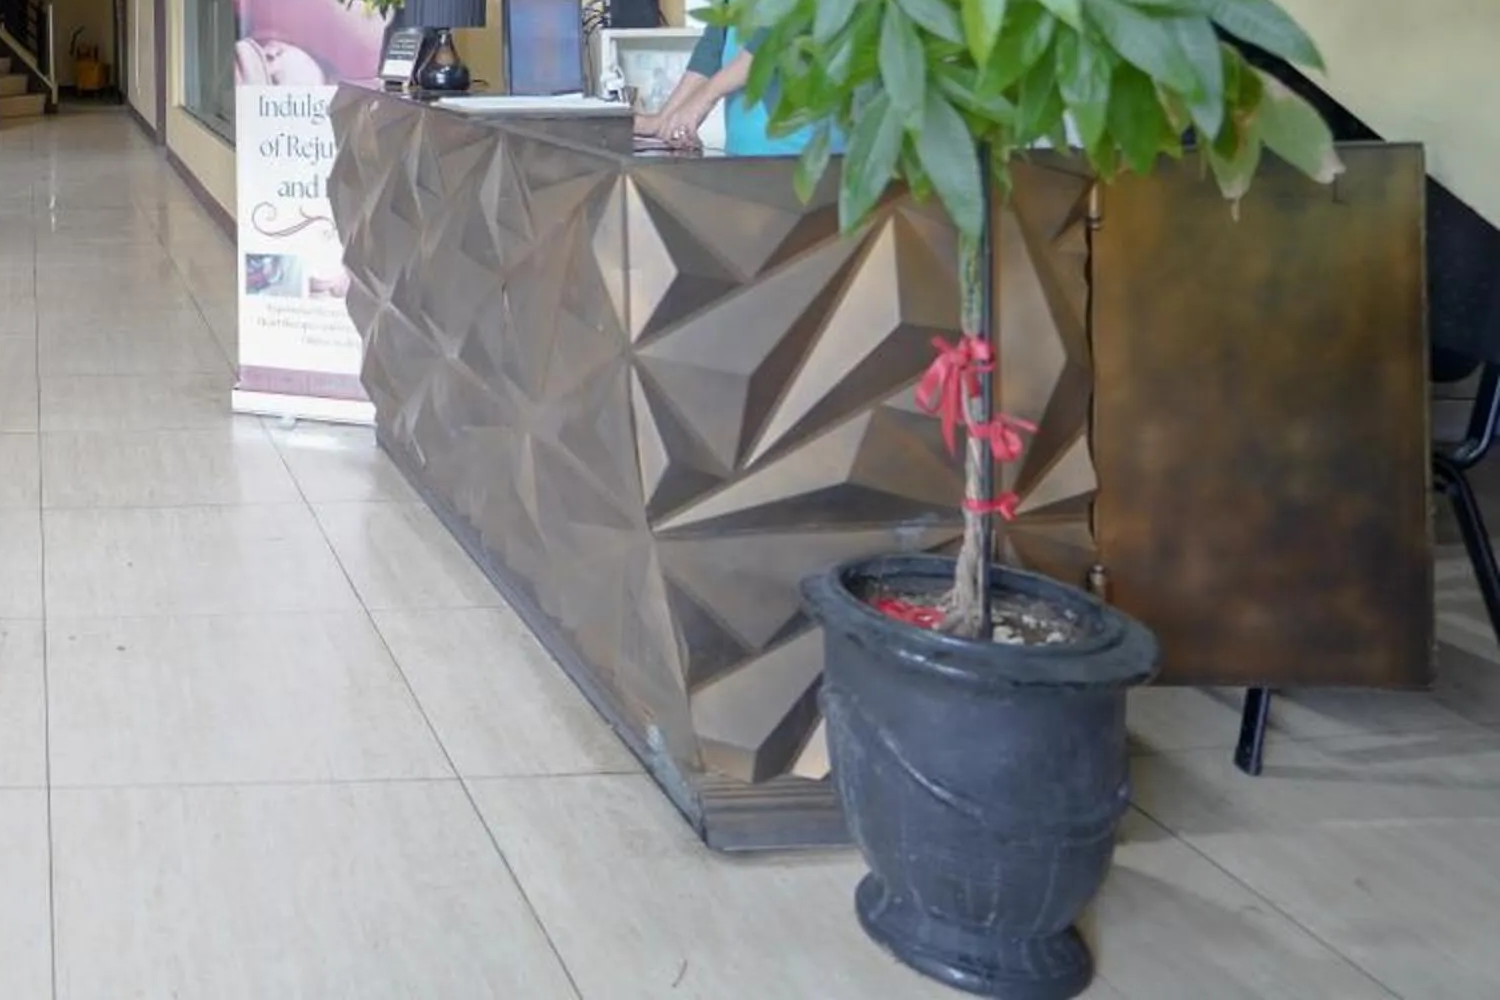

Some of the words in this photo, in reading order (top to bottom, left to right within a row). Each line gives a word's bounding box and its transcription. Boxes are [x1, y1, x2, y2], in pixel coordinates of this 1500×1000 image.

[259, 93, 330, 125] Indulg
[259, 132, 285, 158] of
[277, 173, 319, 199] and
